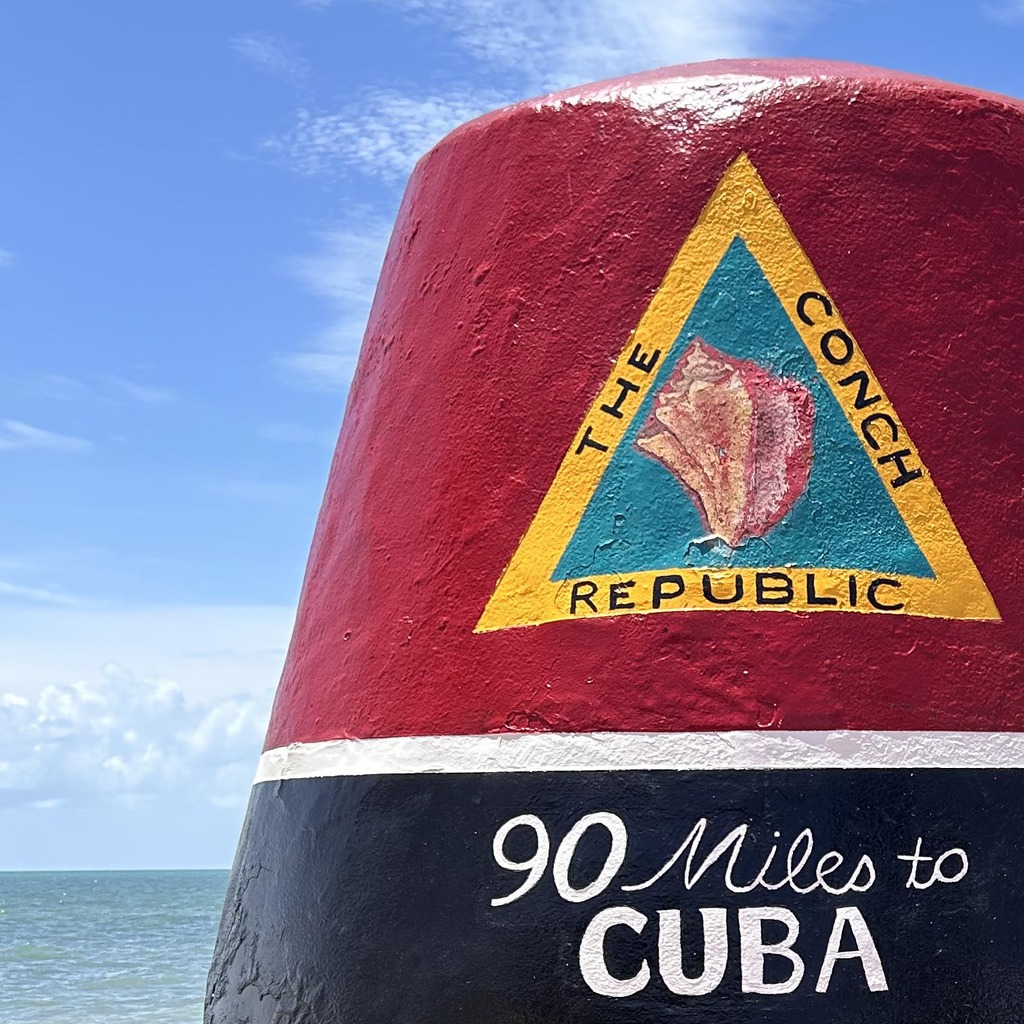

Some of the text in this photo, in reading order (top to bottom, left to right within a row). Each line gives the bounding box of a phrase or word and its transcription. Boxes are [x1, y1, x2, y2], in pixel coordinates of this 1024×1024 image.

[576, 349, 661, 455] THE
[796, 291, 923, 489] CONCH
[570, 572, 905, 615] REPUBLIC
[491, 811, 969, 907] 90 Miles to
[578, 905, 889, 998] CUBA
